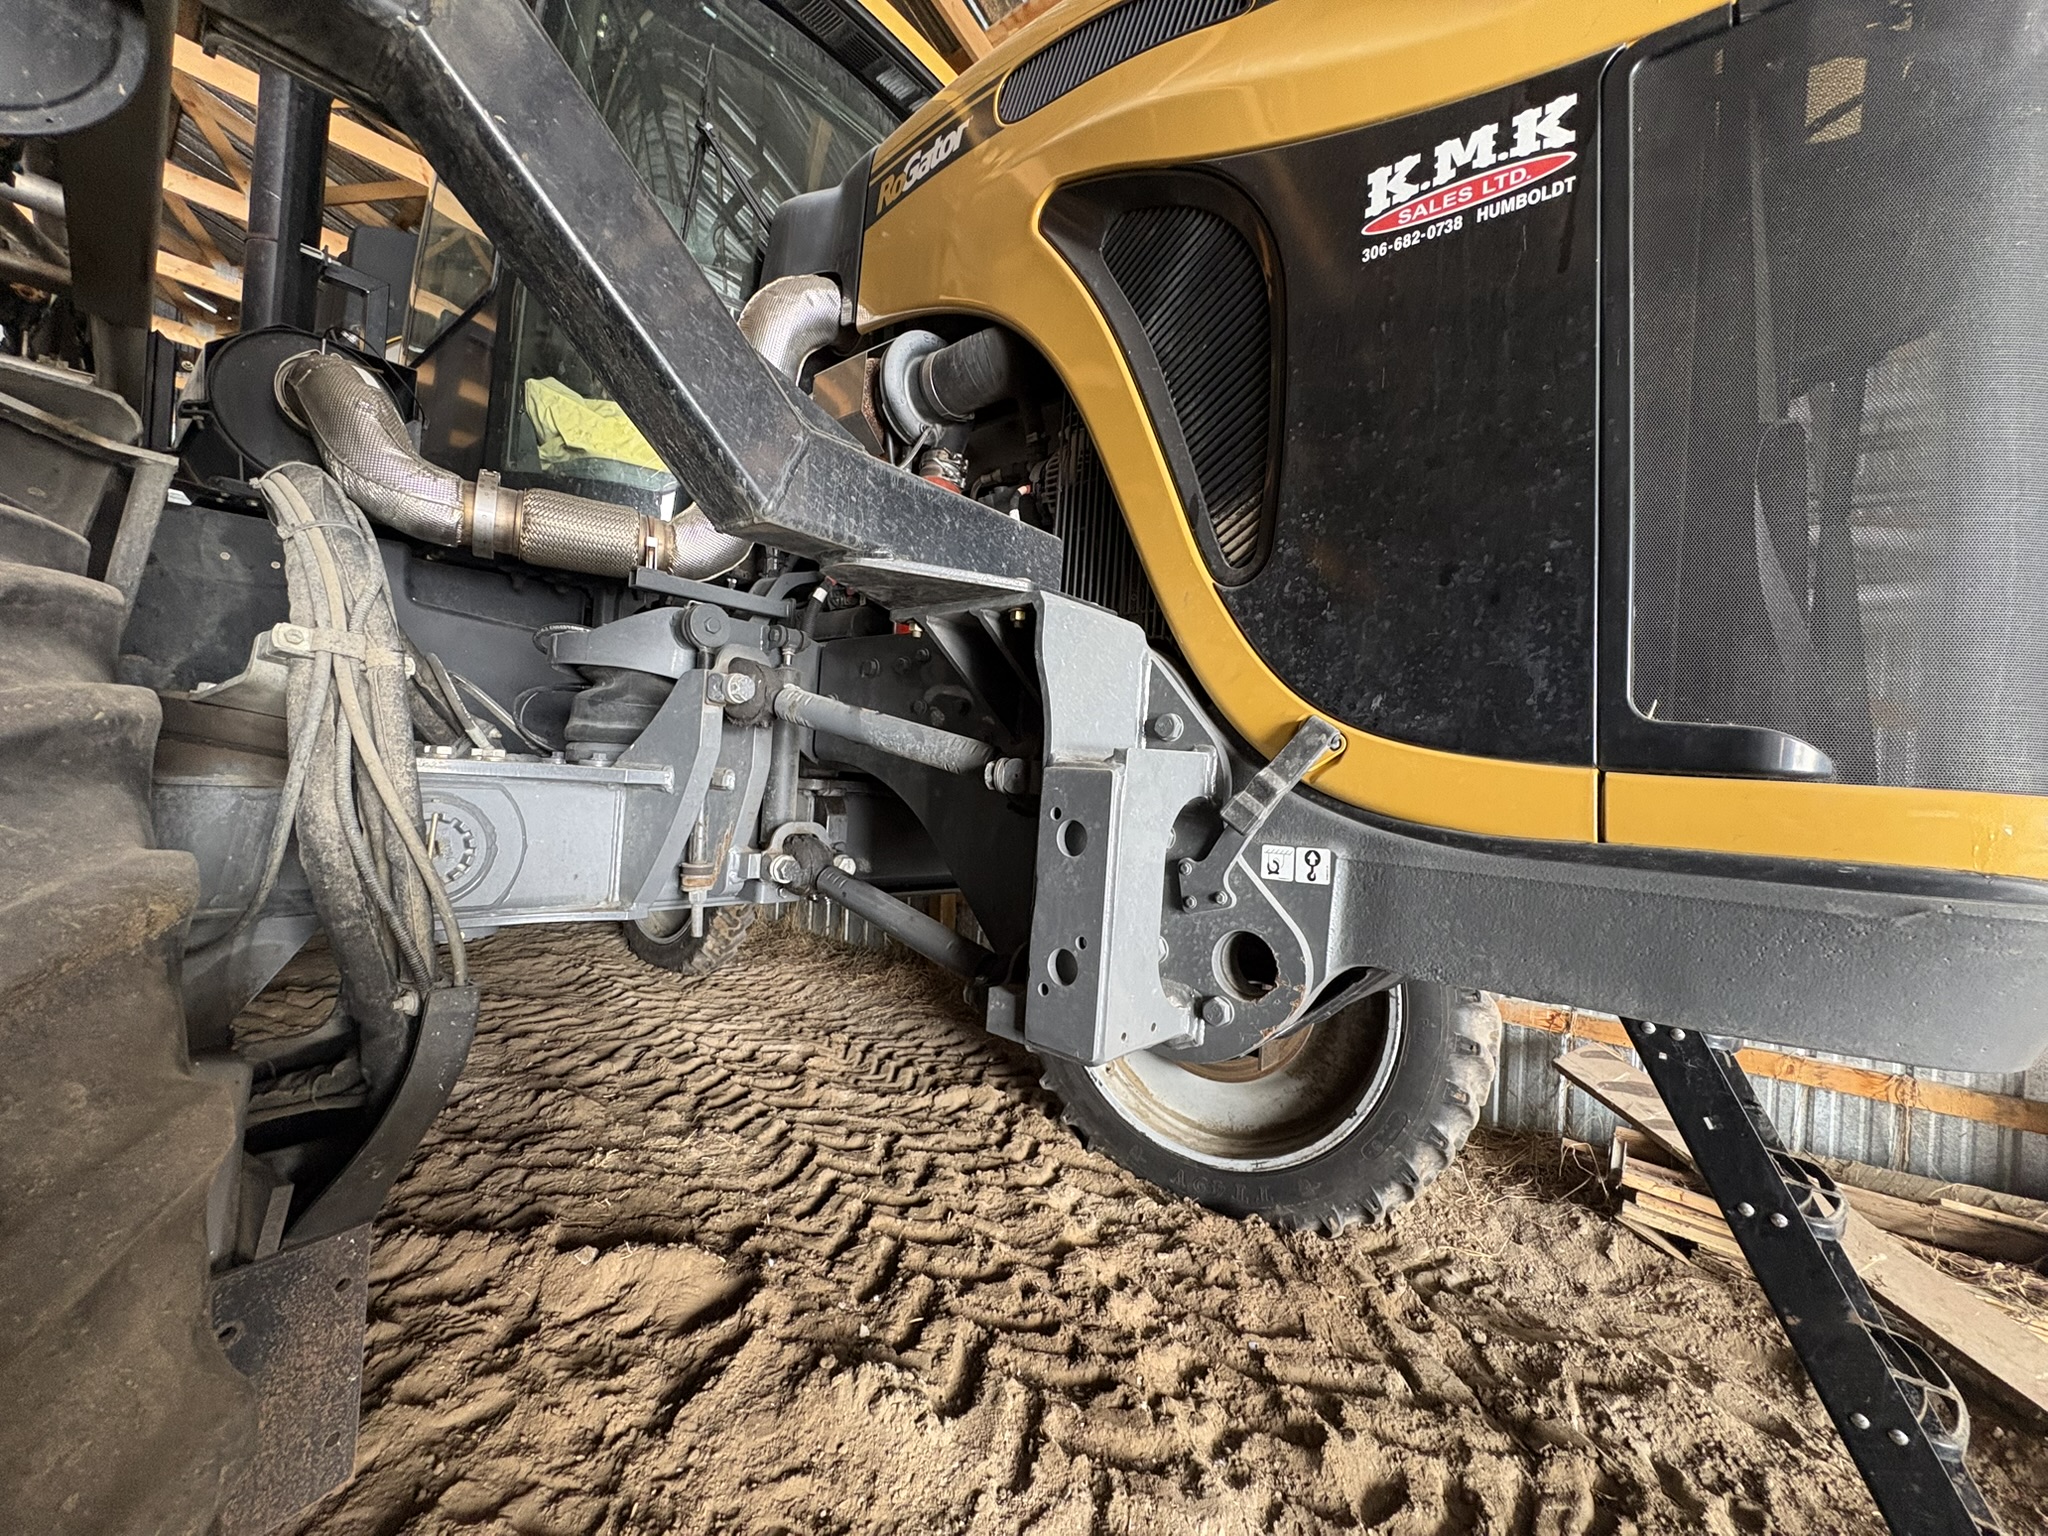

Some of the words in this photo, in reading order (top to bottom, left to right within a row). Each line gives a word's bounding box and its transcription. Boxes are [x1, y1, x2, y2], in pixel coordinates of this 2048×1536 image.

[876, 116, 972, 215] RoGator
[1365, 93, 1578, 218] K.M.K
[1398, 186, 1473, 225] SALES
[1482, 167, 1532, 194] LTD.
[1361, 216, 1464, 263] 306-682-0738
[1476, 175, 1577, 223] HUMBOLDT
